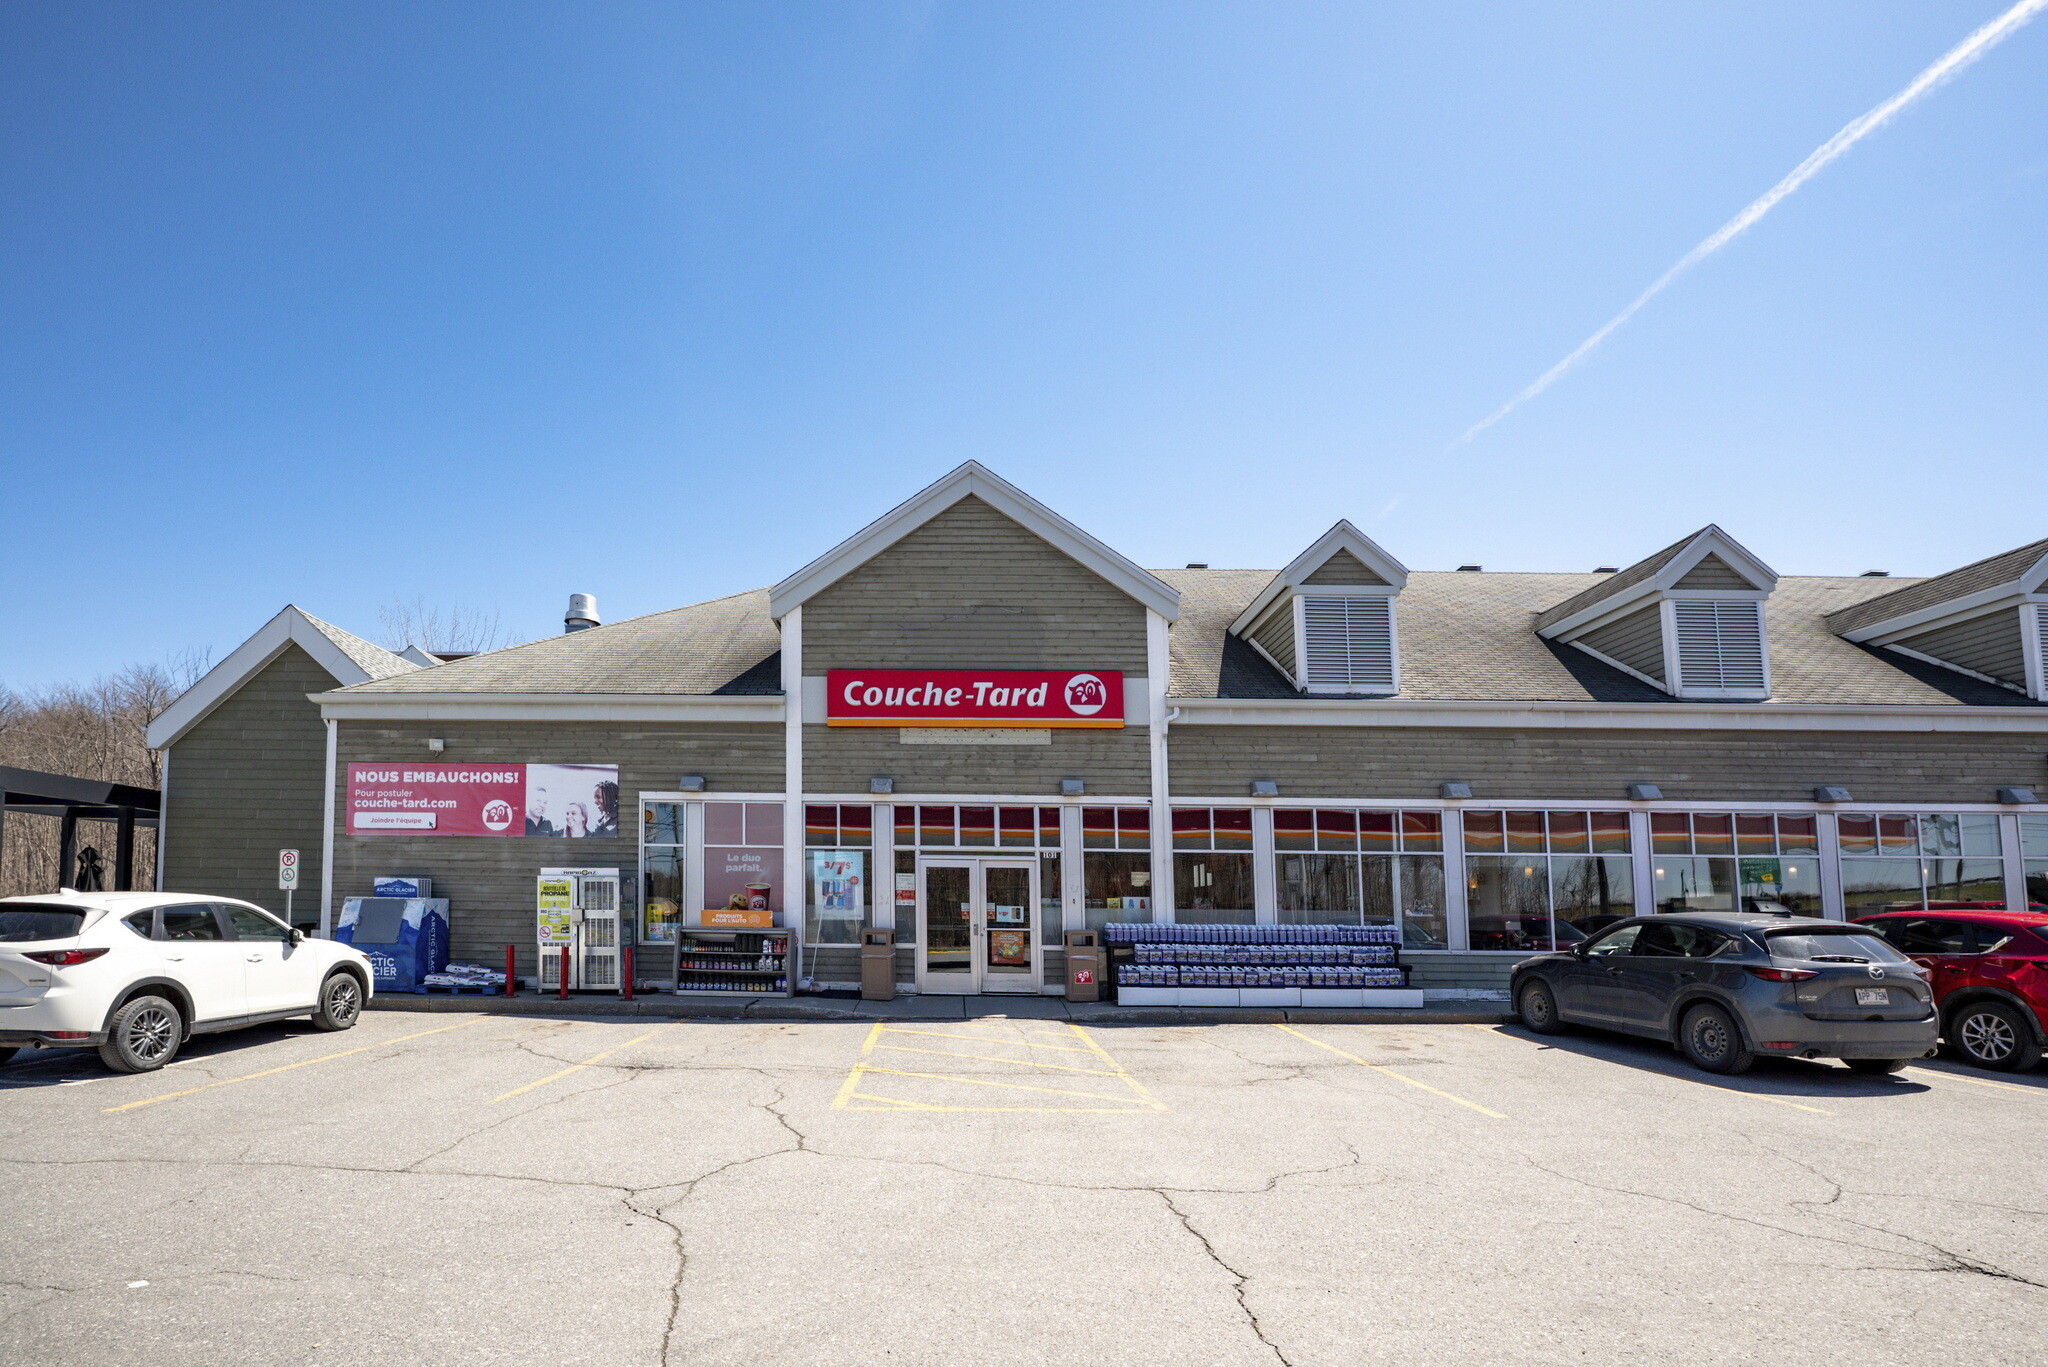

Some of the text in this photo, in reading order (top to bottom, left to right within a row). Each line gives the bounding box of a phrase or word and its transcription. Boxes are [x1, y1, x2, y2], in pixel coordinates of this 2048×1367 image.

[843, 680, 1048, 707] Couche-Tard
[355, 771, 518, 784] NOUS EMBAUCHONS!
[355, 789, 413, 800] Pour postuler
[354, 798, 457, 808] couche-tard.com
[396, 817, 422, 825] l'équipe
[727, 854, 761, 862] Le duo
[726, 864, 763, 872] parfait.
[371, 958, 394, 966] CTIC
[373, 967, 396, 976] CIER
[1858, 992, 1870, 1000] APP
